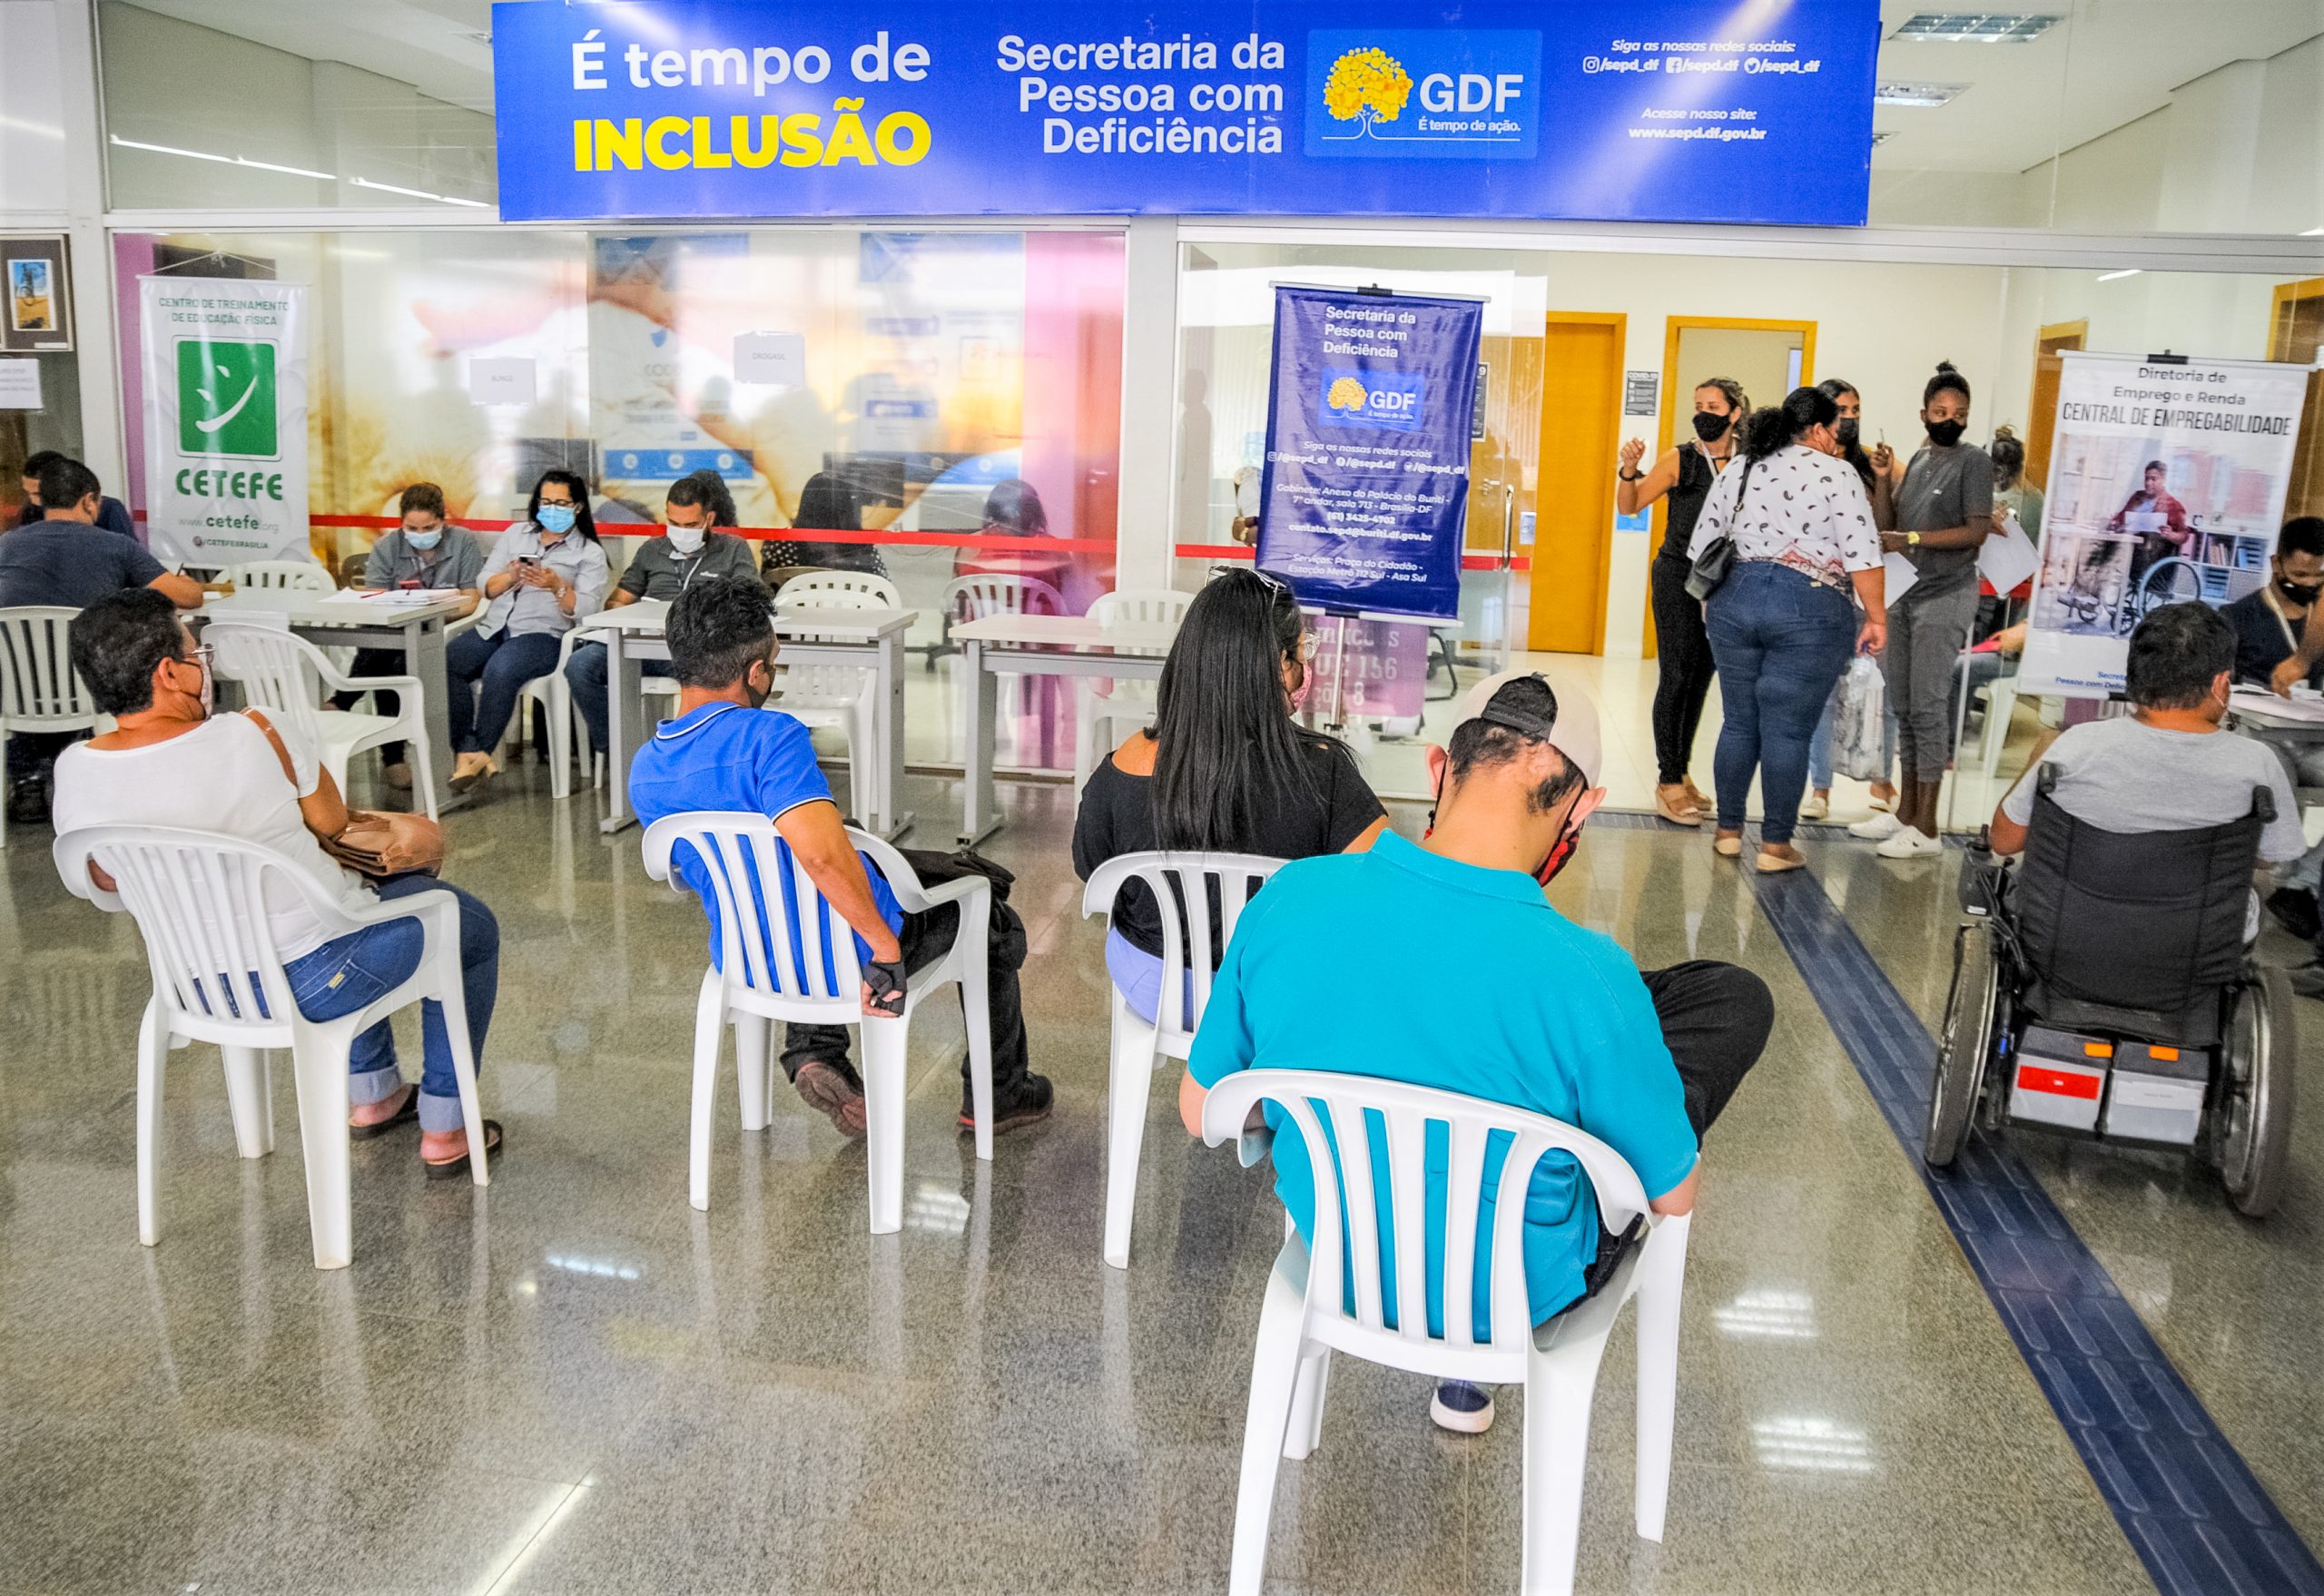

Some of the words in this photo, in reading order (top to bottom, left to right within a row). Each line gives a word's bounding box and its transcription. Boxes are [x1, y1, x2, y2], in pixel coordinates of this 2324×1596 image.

[997, 34, 1217, 72] Secretaria
[1231, 33, 1285, 70] da
[1610, 39, 1641, 54] Siga
[1642, 42, 1659, 52] as
[1661, 42, 1708, 52] nossas
[1709, 41, 1746, 53] redes
[1747, 40, 1797, 53] sociais:
[572, 28, 607, 90] É
[624, 40, 831, 96] tempo
[851, 31, 931, 83] de
[1019, 76, 1175, 113] Pessoa
[1188, 82, 1284, 112] com
[1419, 73, 1524, 113] GDF
[1640, 107, 1687, 120] Acesse
[1689, 109, 1728, 120] nosso
[1728, 107, 1758, 120] site:
[573, 96, 931, 172] INCLUSÃO
[1418, 115, 1428, 131] É
[1429, 120, 1469, 133] tempo
[1470, 119, 1487, 131] de
[1488, 119, 1521, 134] ação.
[1629, 126, 1768, 142] www.sepd.df.gov.br
[1043, 116, 1283, 153] Deficiência
[159, 297, 199, 308] CENTRO
[202, 299, 215, 309] DE
[217, 300, 289, 310] TREINAMENTO
[172, 312, 184, 322] DE
[187, 312, 242, 325] EDUCAÇÃO
[1325, 305, 1396, 323] Secretaria
[1398, 311, 1417, 325] da
[1324, 323, 1374, 340] Pessoa
[1377, 330, 1409, 341] com
[1323, 340, 1399, 359] Deficiência
[2138, 367, 2204, 382] Diretoria
[2208, 367, 2228, 383] de
[1369, 390, 1417, 410] GDF
[2113, 385, 2181, 403] Emprego
[2185, 392, 2194, 402] e
[2197, 390, 2248, 406] Renda
[2063, 402, 2127, 425] CENTRAL
[2131, 407, 2152, 426] DE
[2153, 409, 2293, 436] EMPREGABILIDADE
[1304, 441, 1324, 452] Siga
[1325, 443, 1338, 451] as
[1339, 445, 1372, 454] nossas
[1373, 447, 1399, 456] redes
[1399, 448, 1433, 458] sociais
[175, 468, 283, 501] CETEFE
[1275, 482, 1322, 496] Gabinete:
[1322, 487, 1353, 497] Anexo
[1353, 489, 1366, 498] do
[1403, 493, 1417, 502] do
[1417, 494, 1445, 505] Buriti
[1304, 498, 1334, 507] andar,
[1335, 500, 1357, 508] sala
[1291, 554, 1334, 566] Serviços:
[1334, 557, 1363, 567] Praça
[1364, 559, 1377, 568] do
[1377, 559, 1415, 571] Cidadão
[1286, 564, 1325, 576] Estação
[1369, 569, 1385, 579] Sul
[1392, 571, 1410, 582] Asa
[1411, 573, 1428, 583] Sul
[2098, 672, 2127, 681] Secret
[2104, 681, 2127, 690] Defic
